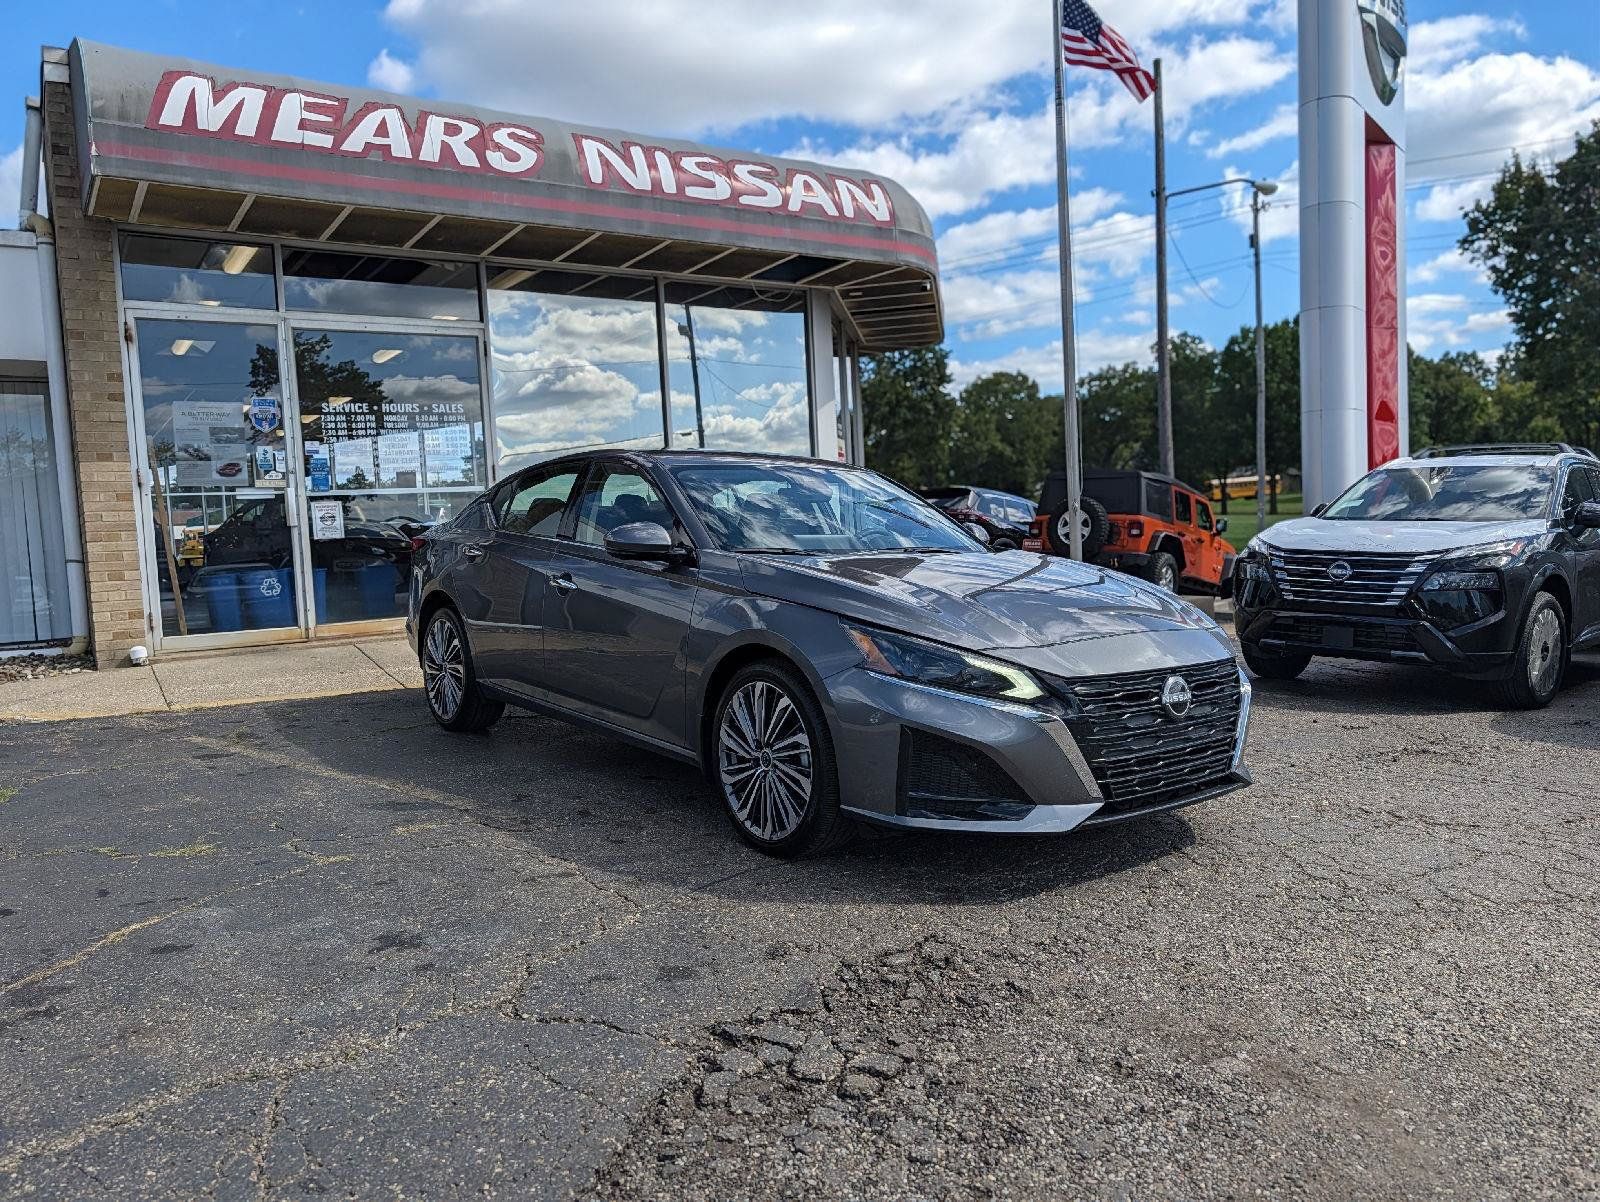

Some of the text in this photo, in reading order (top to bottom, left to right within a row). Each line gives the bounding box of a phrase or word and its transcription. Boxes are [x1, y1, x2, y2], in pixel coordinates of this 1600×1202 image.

[158, 75, 892, 223] MEARS NISSAN
[321, 402, 464, 413] SERVICE HOURS SALES
[336, 414, 346, 422] AM
[366, 414, 376, 422] PM
[383, 414, 408, 422] MONDAY
[429, 414, 438, 422] AM
[337, 421, 347, 429] AM
[366, 421, 376, 429] PM
[1163, 691, 1192, 704] NISSAN
